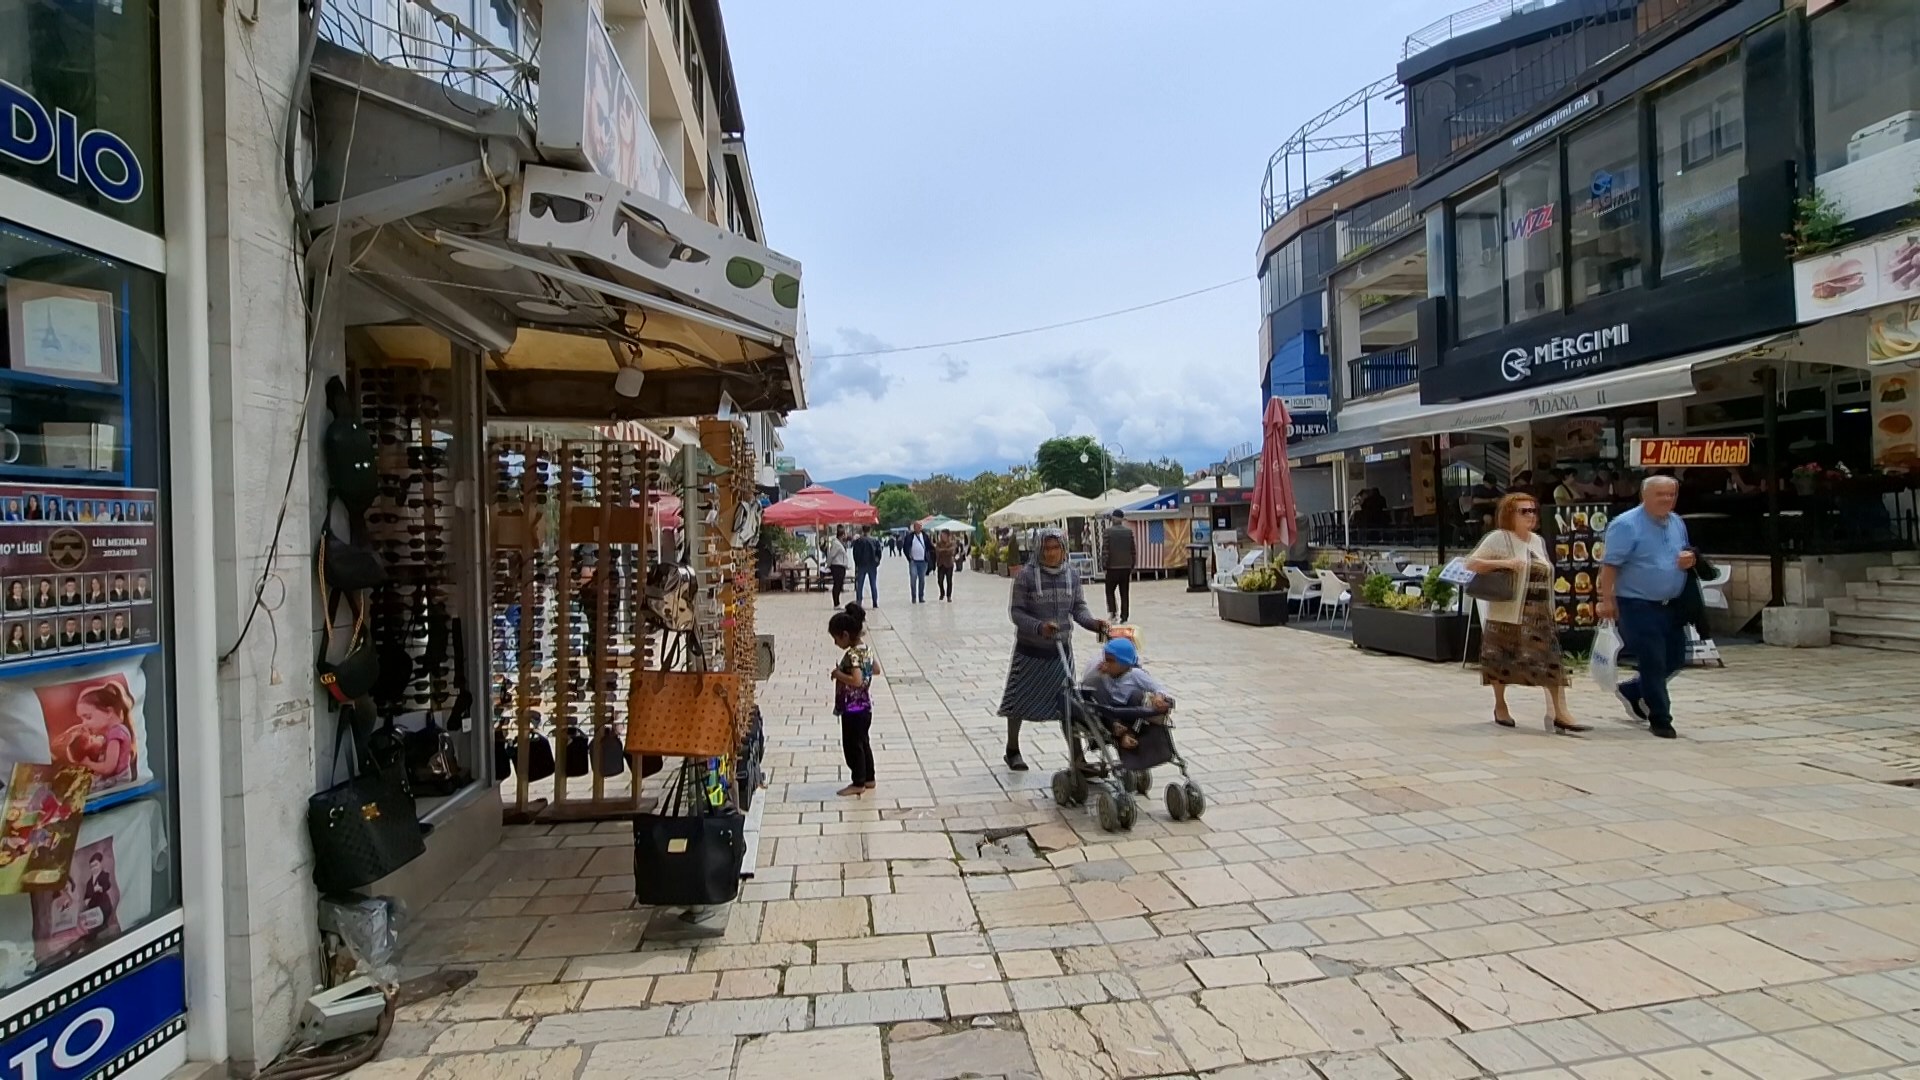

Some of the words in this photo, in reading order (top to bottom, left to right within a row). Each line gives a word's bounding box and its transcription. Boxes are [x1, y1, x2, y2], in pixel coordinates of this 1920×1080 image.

[0, 78, 144, 203] DIO
[1562, 350, 1603, 371] Travel
[1532, 395, 1579, 415] ADANA
[1660, 440, 1702, 464] Döner
[1703, 440, 1746, 464] Kebab
